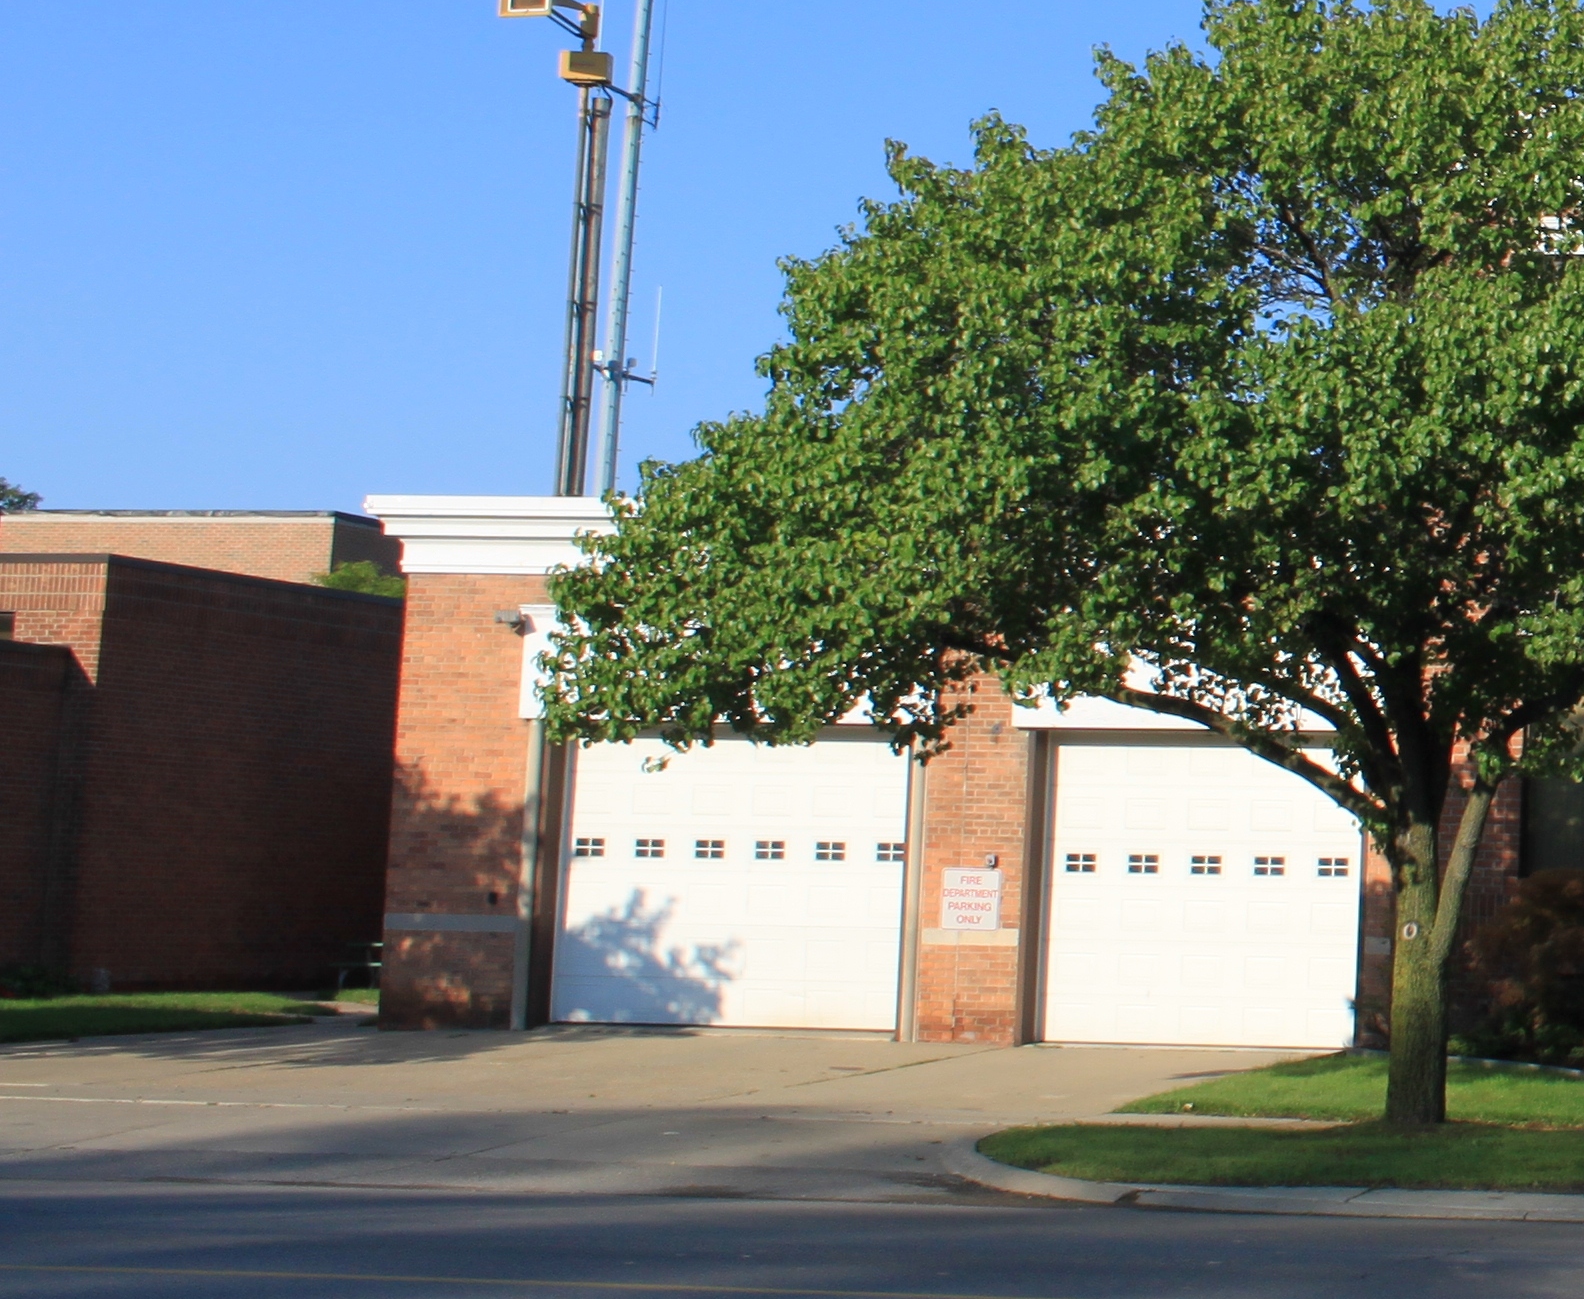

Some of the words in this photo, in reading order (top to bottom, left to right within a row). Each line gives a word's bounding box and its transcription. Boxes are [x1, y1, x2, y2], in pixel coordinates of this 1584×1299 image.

[960, 875, 982, 885] FIRE
[943, 888, 998, 898] DEPARTMENT
[948, 901, 991, 911] PARKING
[956, 914, 982, 924] ONLY
